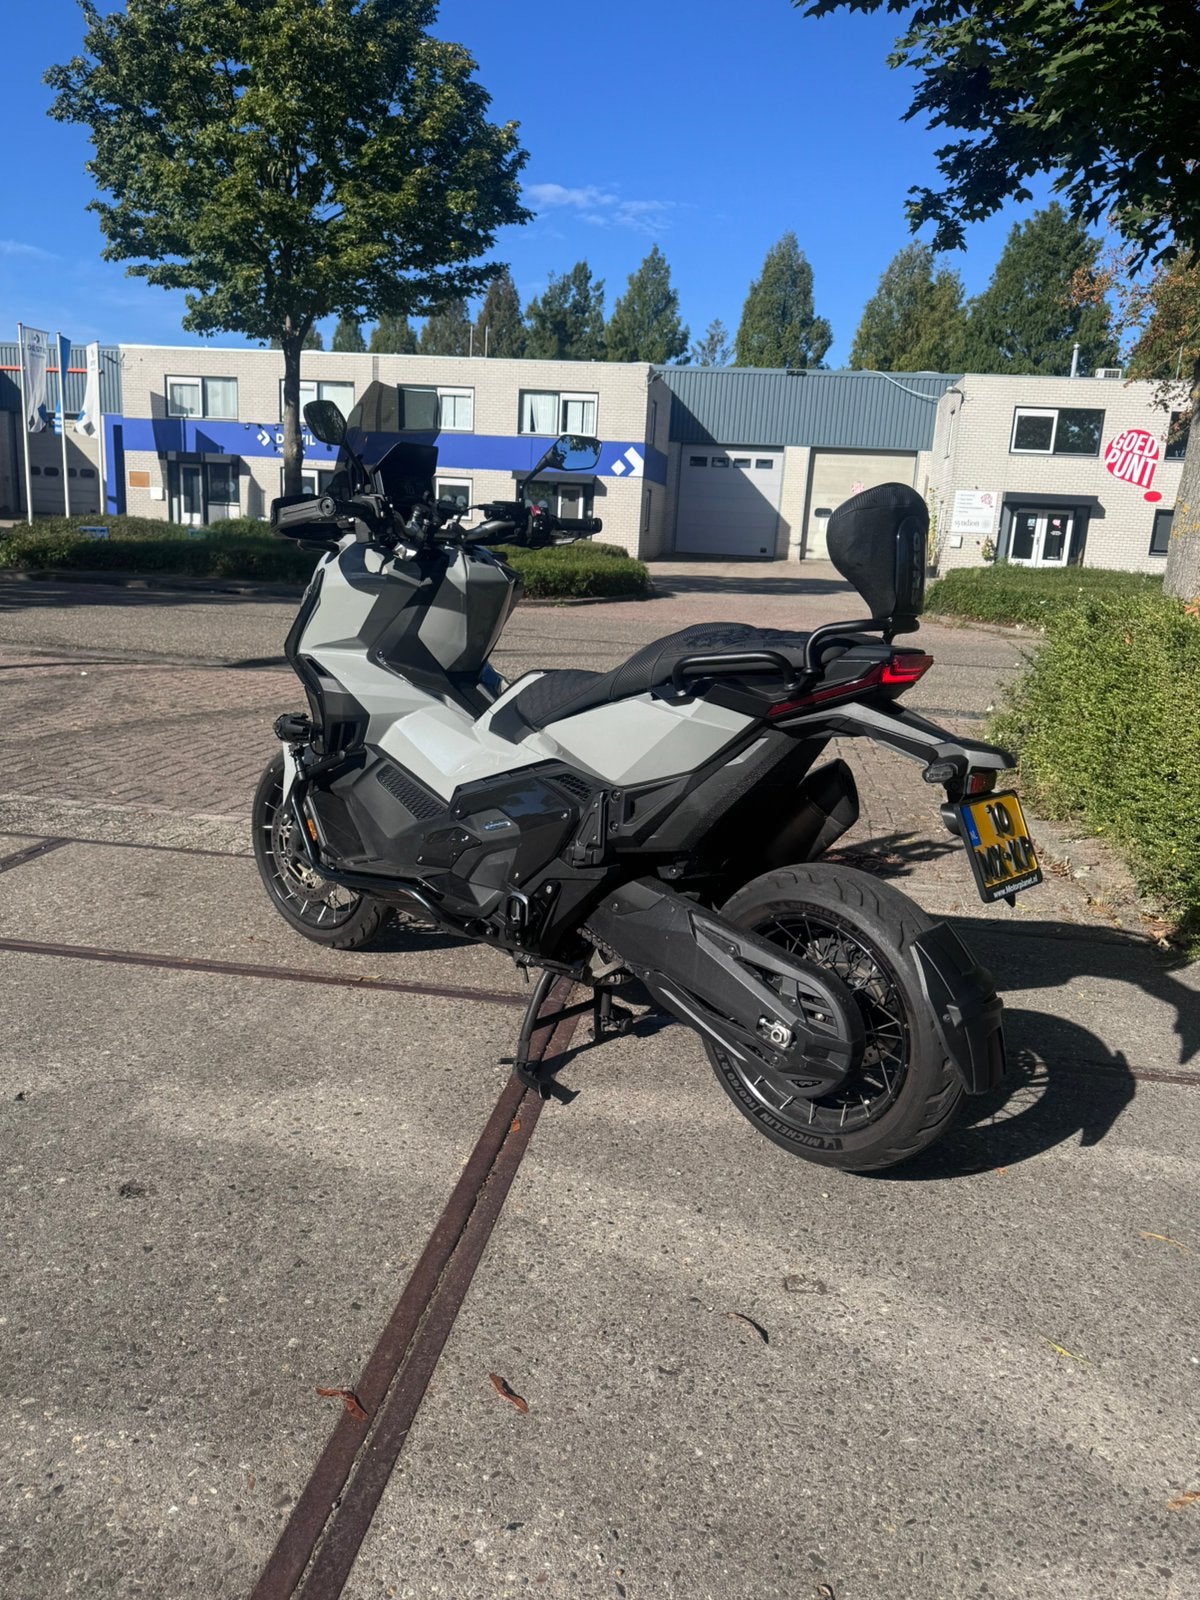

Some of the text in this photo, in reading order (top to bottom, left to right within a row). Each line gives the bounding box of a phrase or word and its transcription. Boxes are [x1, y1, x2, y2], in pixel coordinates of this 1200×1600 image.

[276, 433, 316, 446] DIL
[1111, 431, 1159, 457] GOED
[1105, 448, 1158, 488] PUNT
[985, 802, 1015, 838] 10
[721, 1061, 731, 1071] R
[727, 1072, 757, 1109] 160/60
[760, 1111, 821, 1148] MICHELIN
